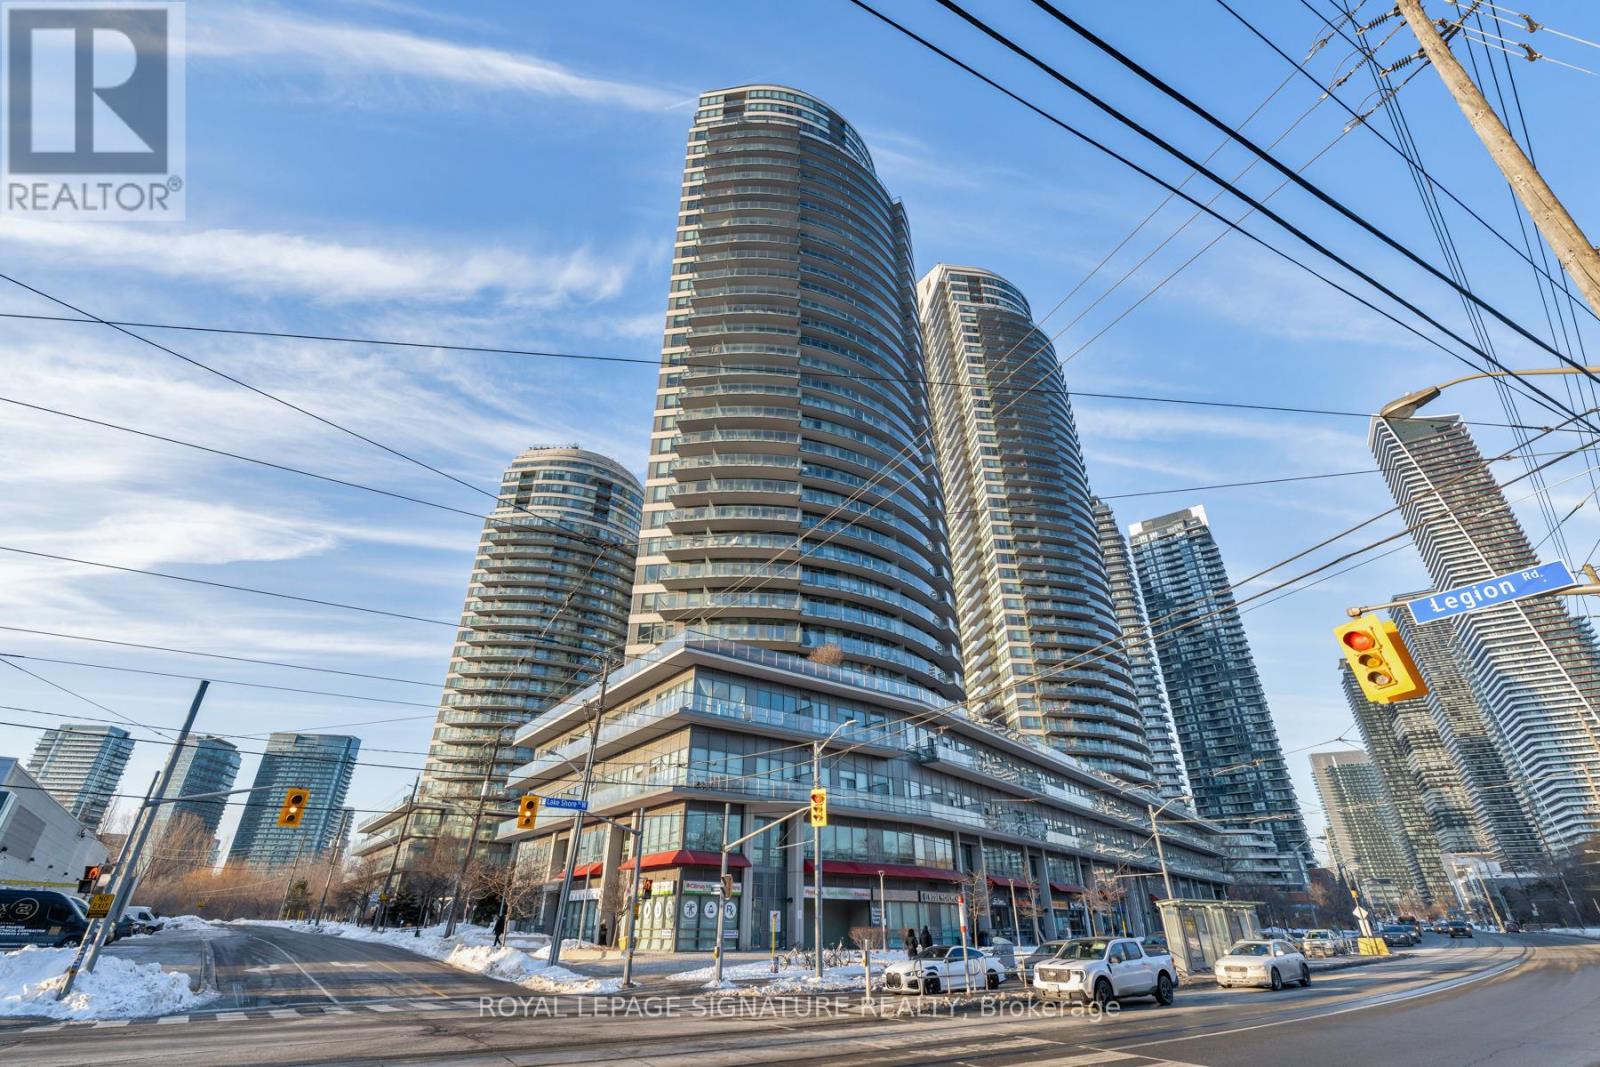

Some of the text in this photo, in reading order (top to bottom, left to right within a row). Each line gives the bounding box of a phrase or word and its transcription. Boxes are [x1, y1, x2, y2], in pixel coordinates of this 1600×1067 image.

[1430, 569, 1544, 613] Legion Rd.
[561, 799, 577, 808] Shore
